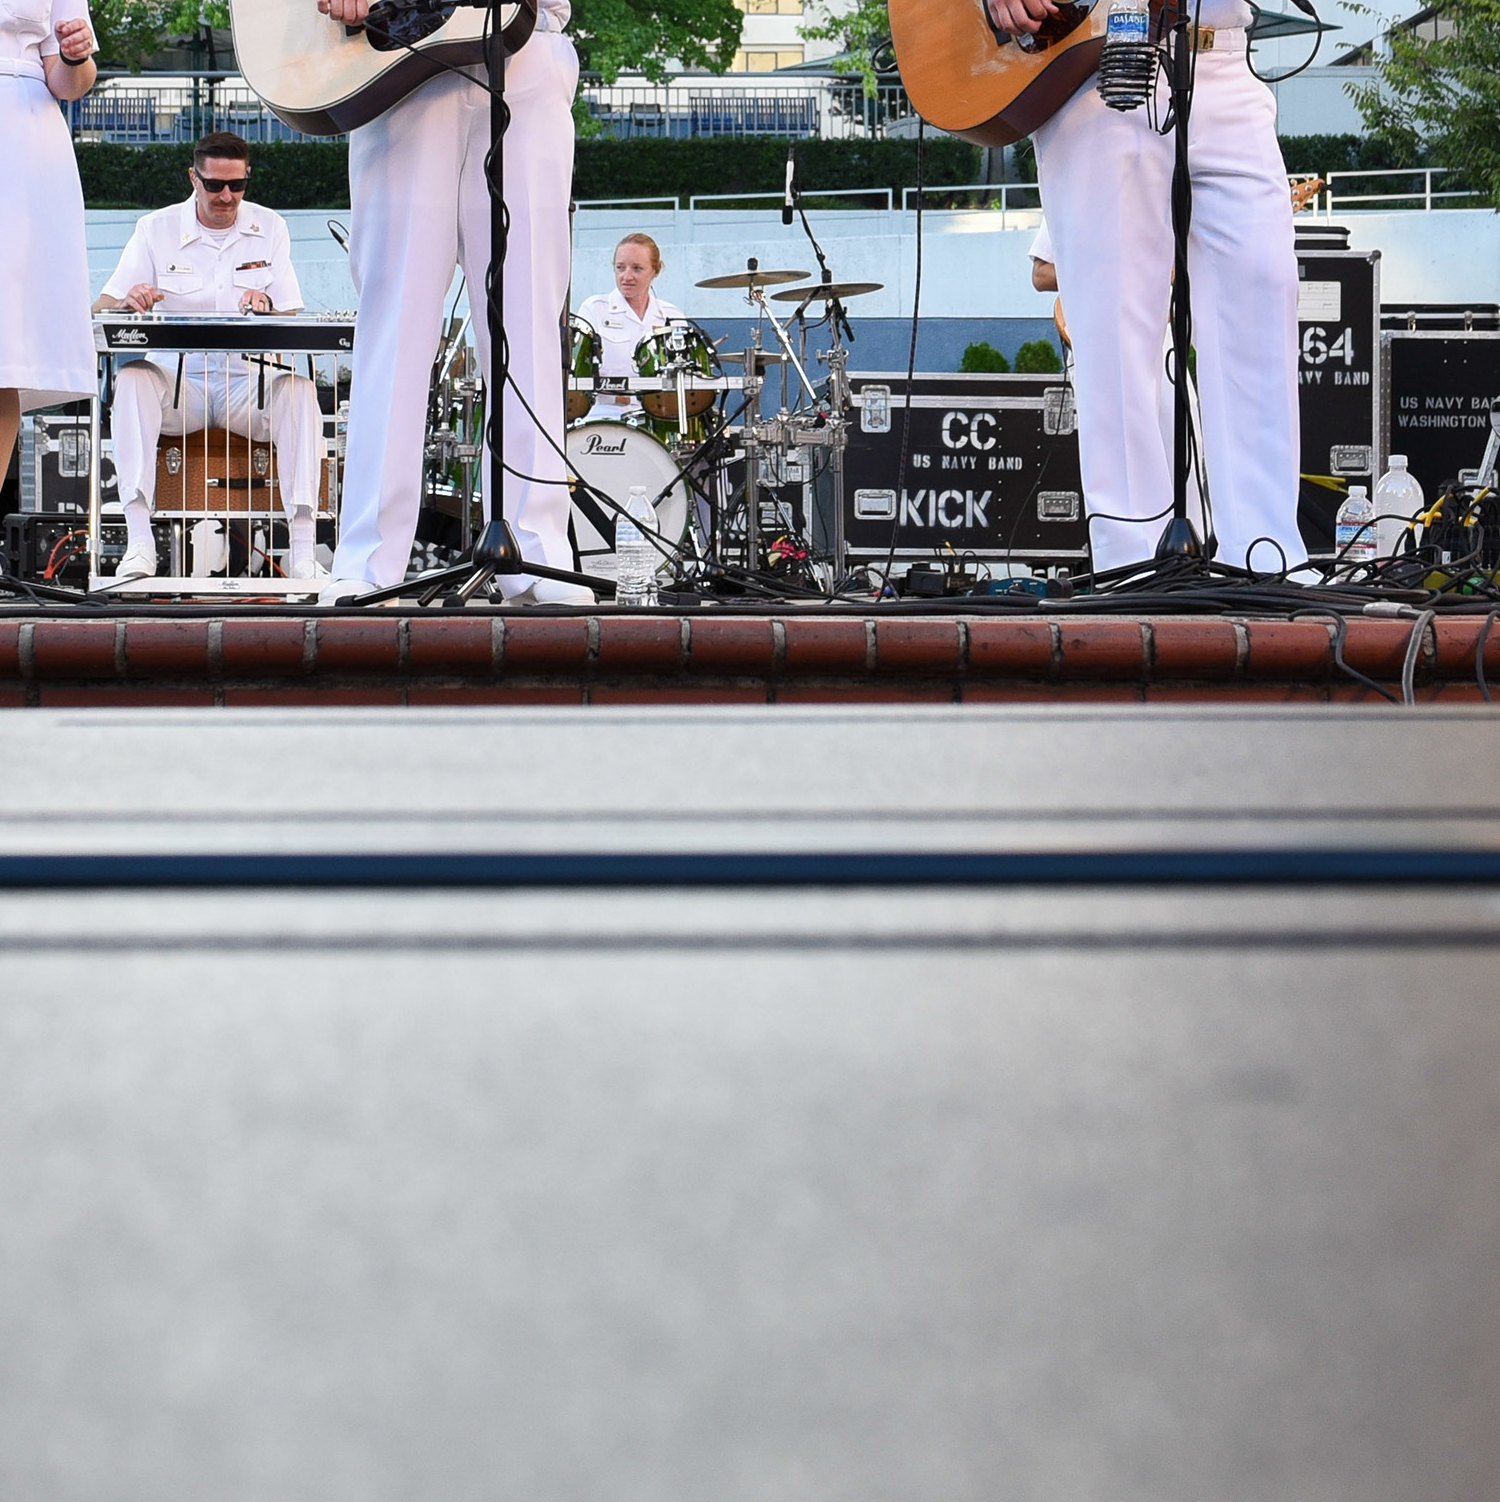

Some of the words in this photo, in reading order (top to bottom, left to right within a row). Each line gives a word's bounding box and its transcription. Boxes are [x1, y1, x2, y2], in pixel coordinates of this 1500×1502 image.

[1297, 326, 1355, 366] 64
[595, 378, 627, 391] Pearl
[1298, 371, 1323, 386] AVY
[1334, 371, 1370, 386] BAND
[1400, 396, 1419, 409] US
[1425, 396, 1464, 409] NAVY
[941, 411, 997, 450] CC
[1398, 415, 1486, 428] WASHINGTON
[580, 434, 627, 455] Pearl
[912, 453, 931, 468] US
[941, 455, 977, 470] NAVY
[988, 456, 1023, 471] BAND
[899, 488, 993, 528] KICK
